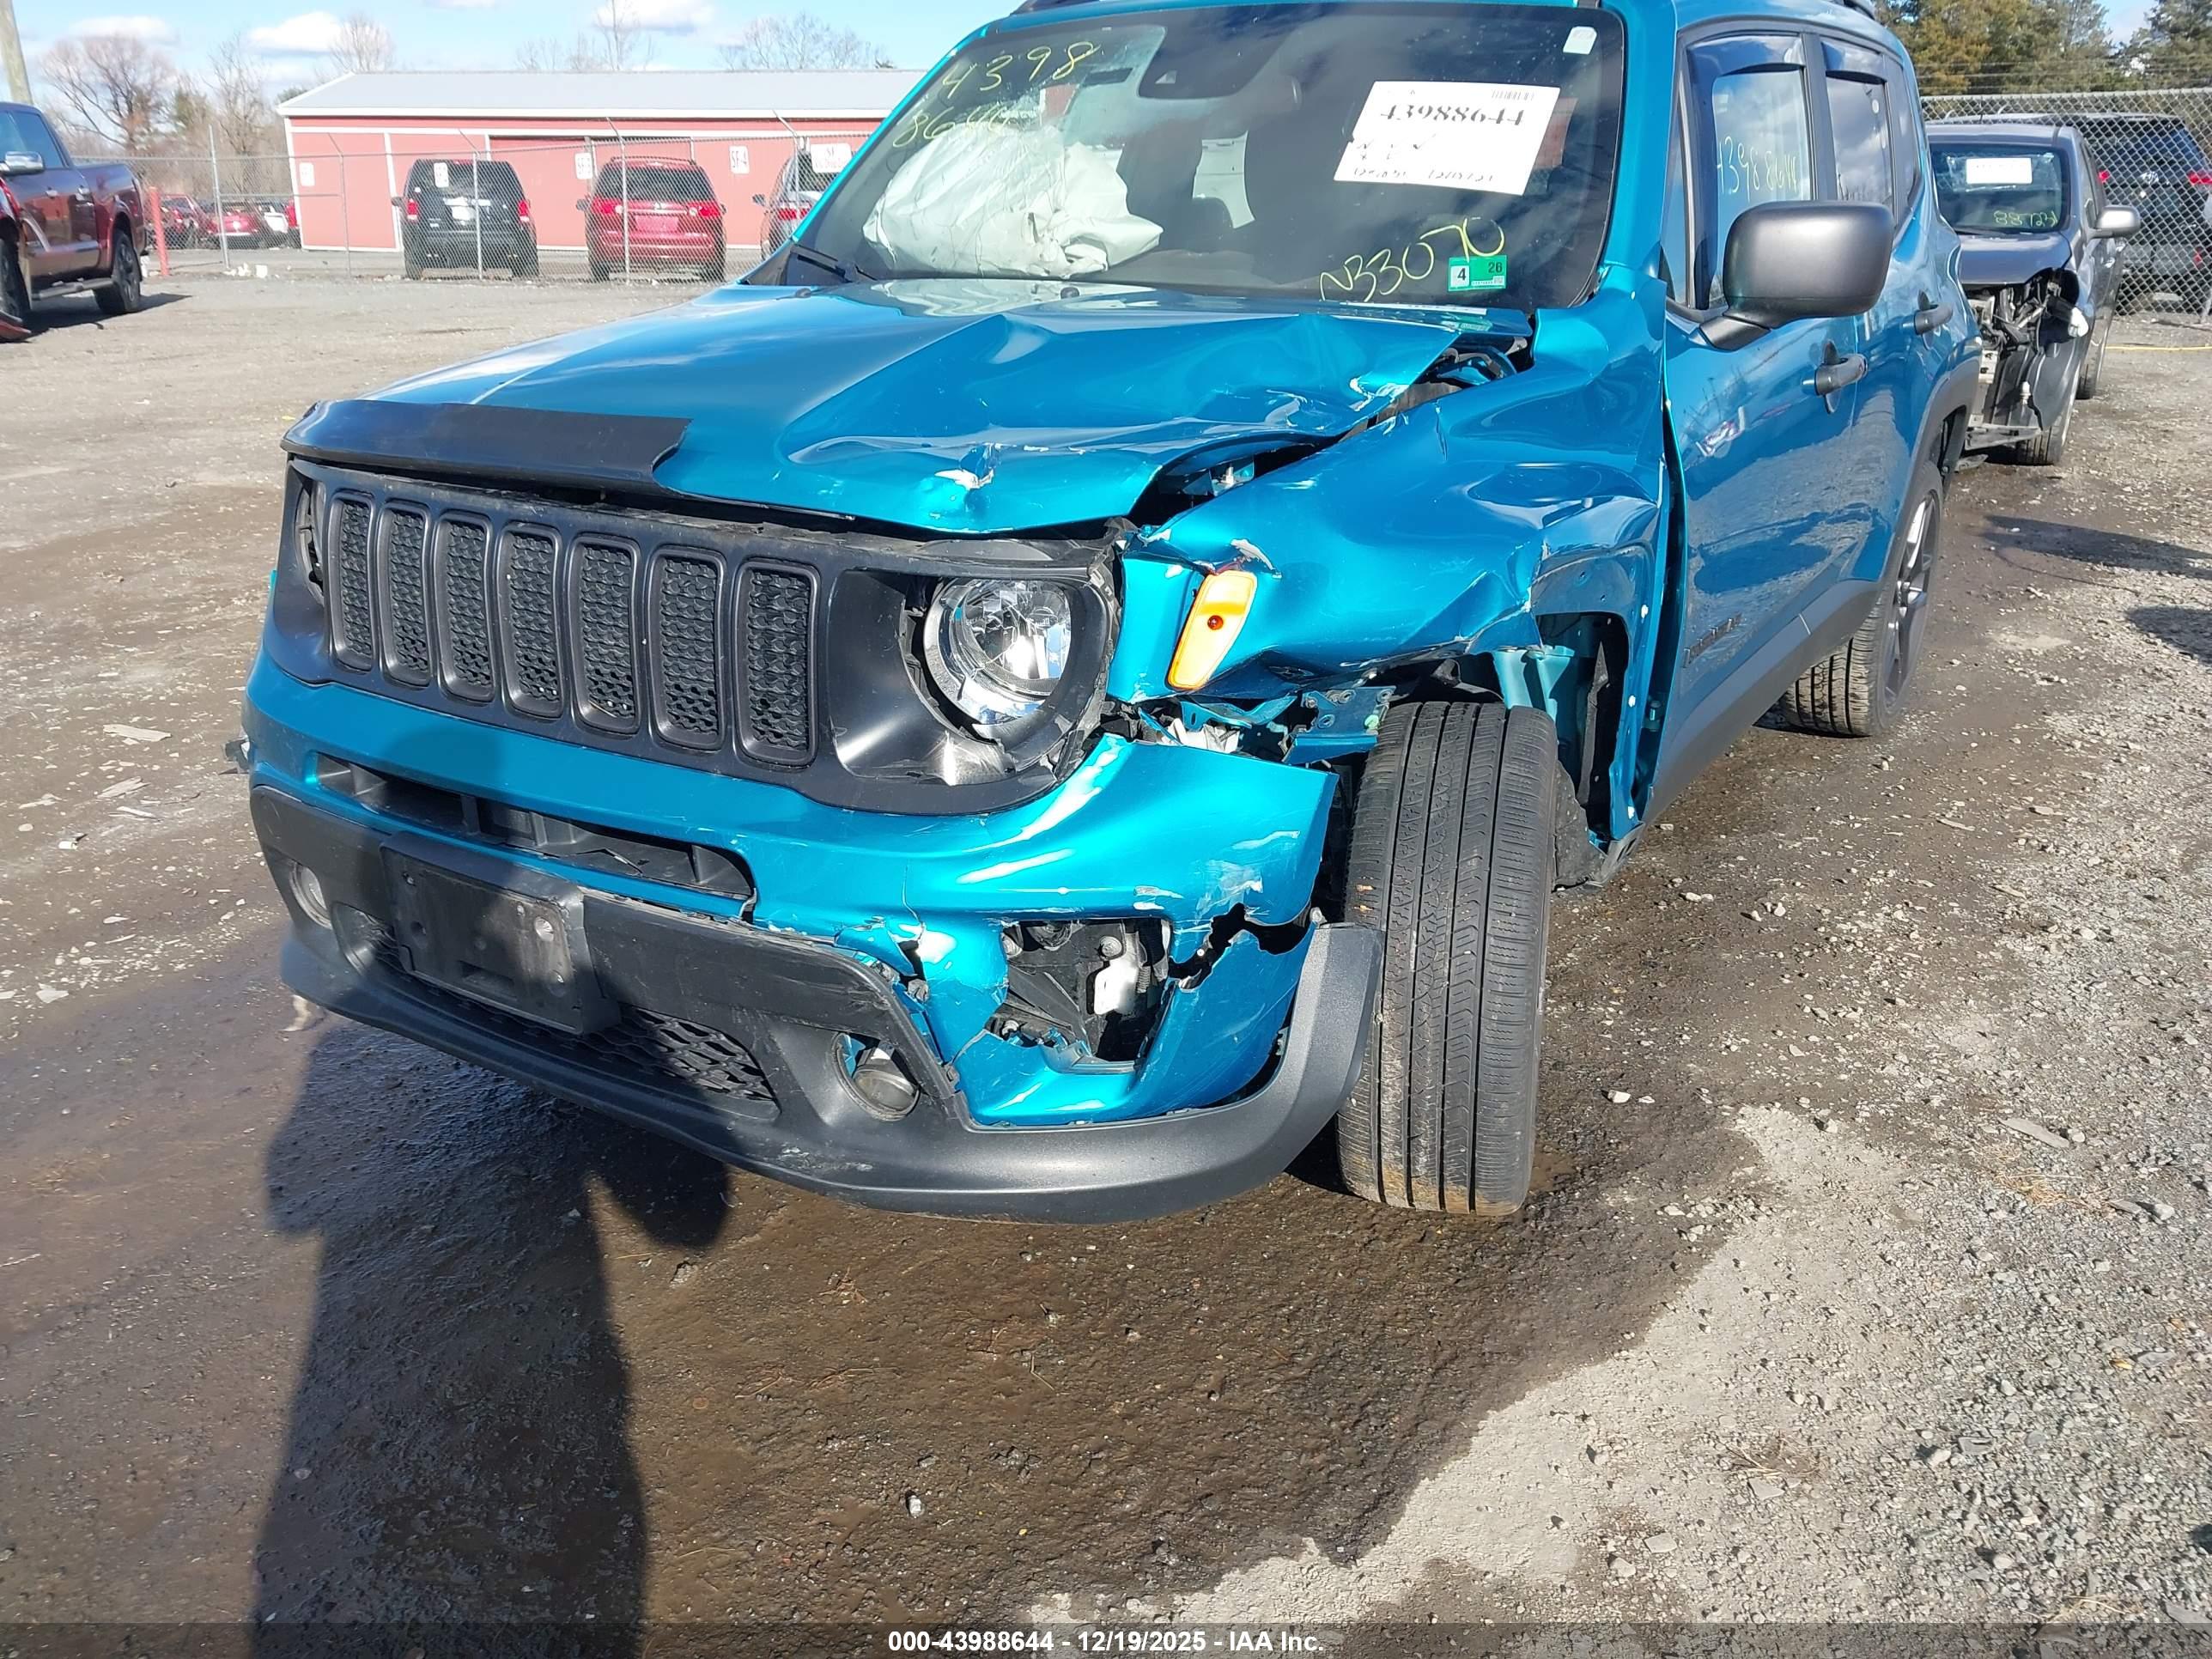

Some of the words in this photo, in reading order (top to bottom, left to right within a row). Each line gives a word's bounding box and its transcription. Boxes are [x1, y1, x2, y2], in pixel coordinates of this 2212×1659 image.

[943, 41, 1101, 100] 4398
[1380, 103, 1525, 126] 43988644
[1456, 267, 1467, 281] 4
[1488, 261, 1503, 274] 26
